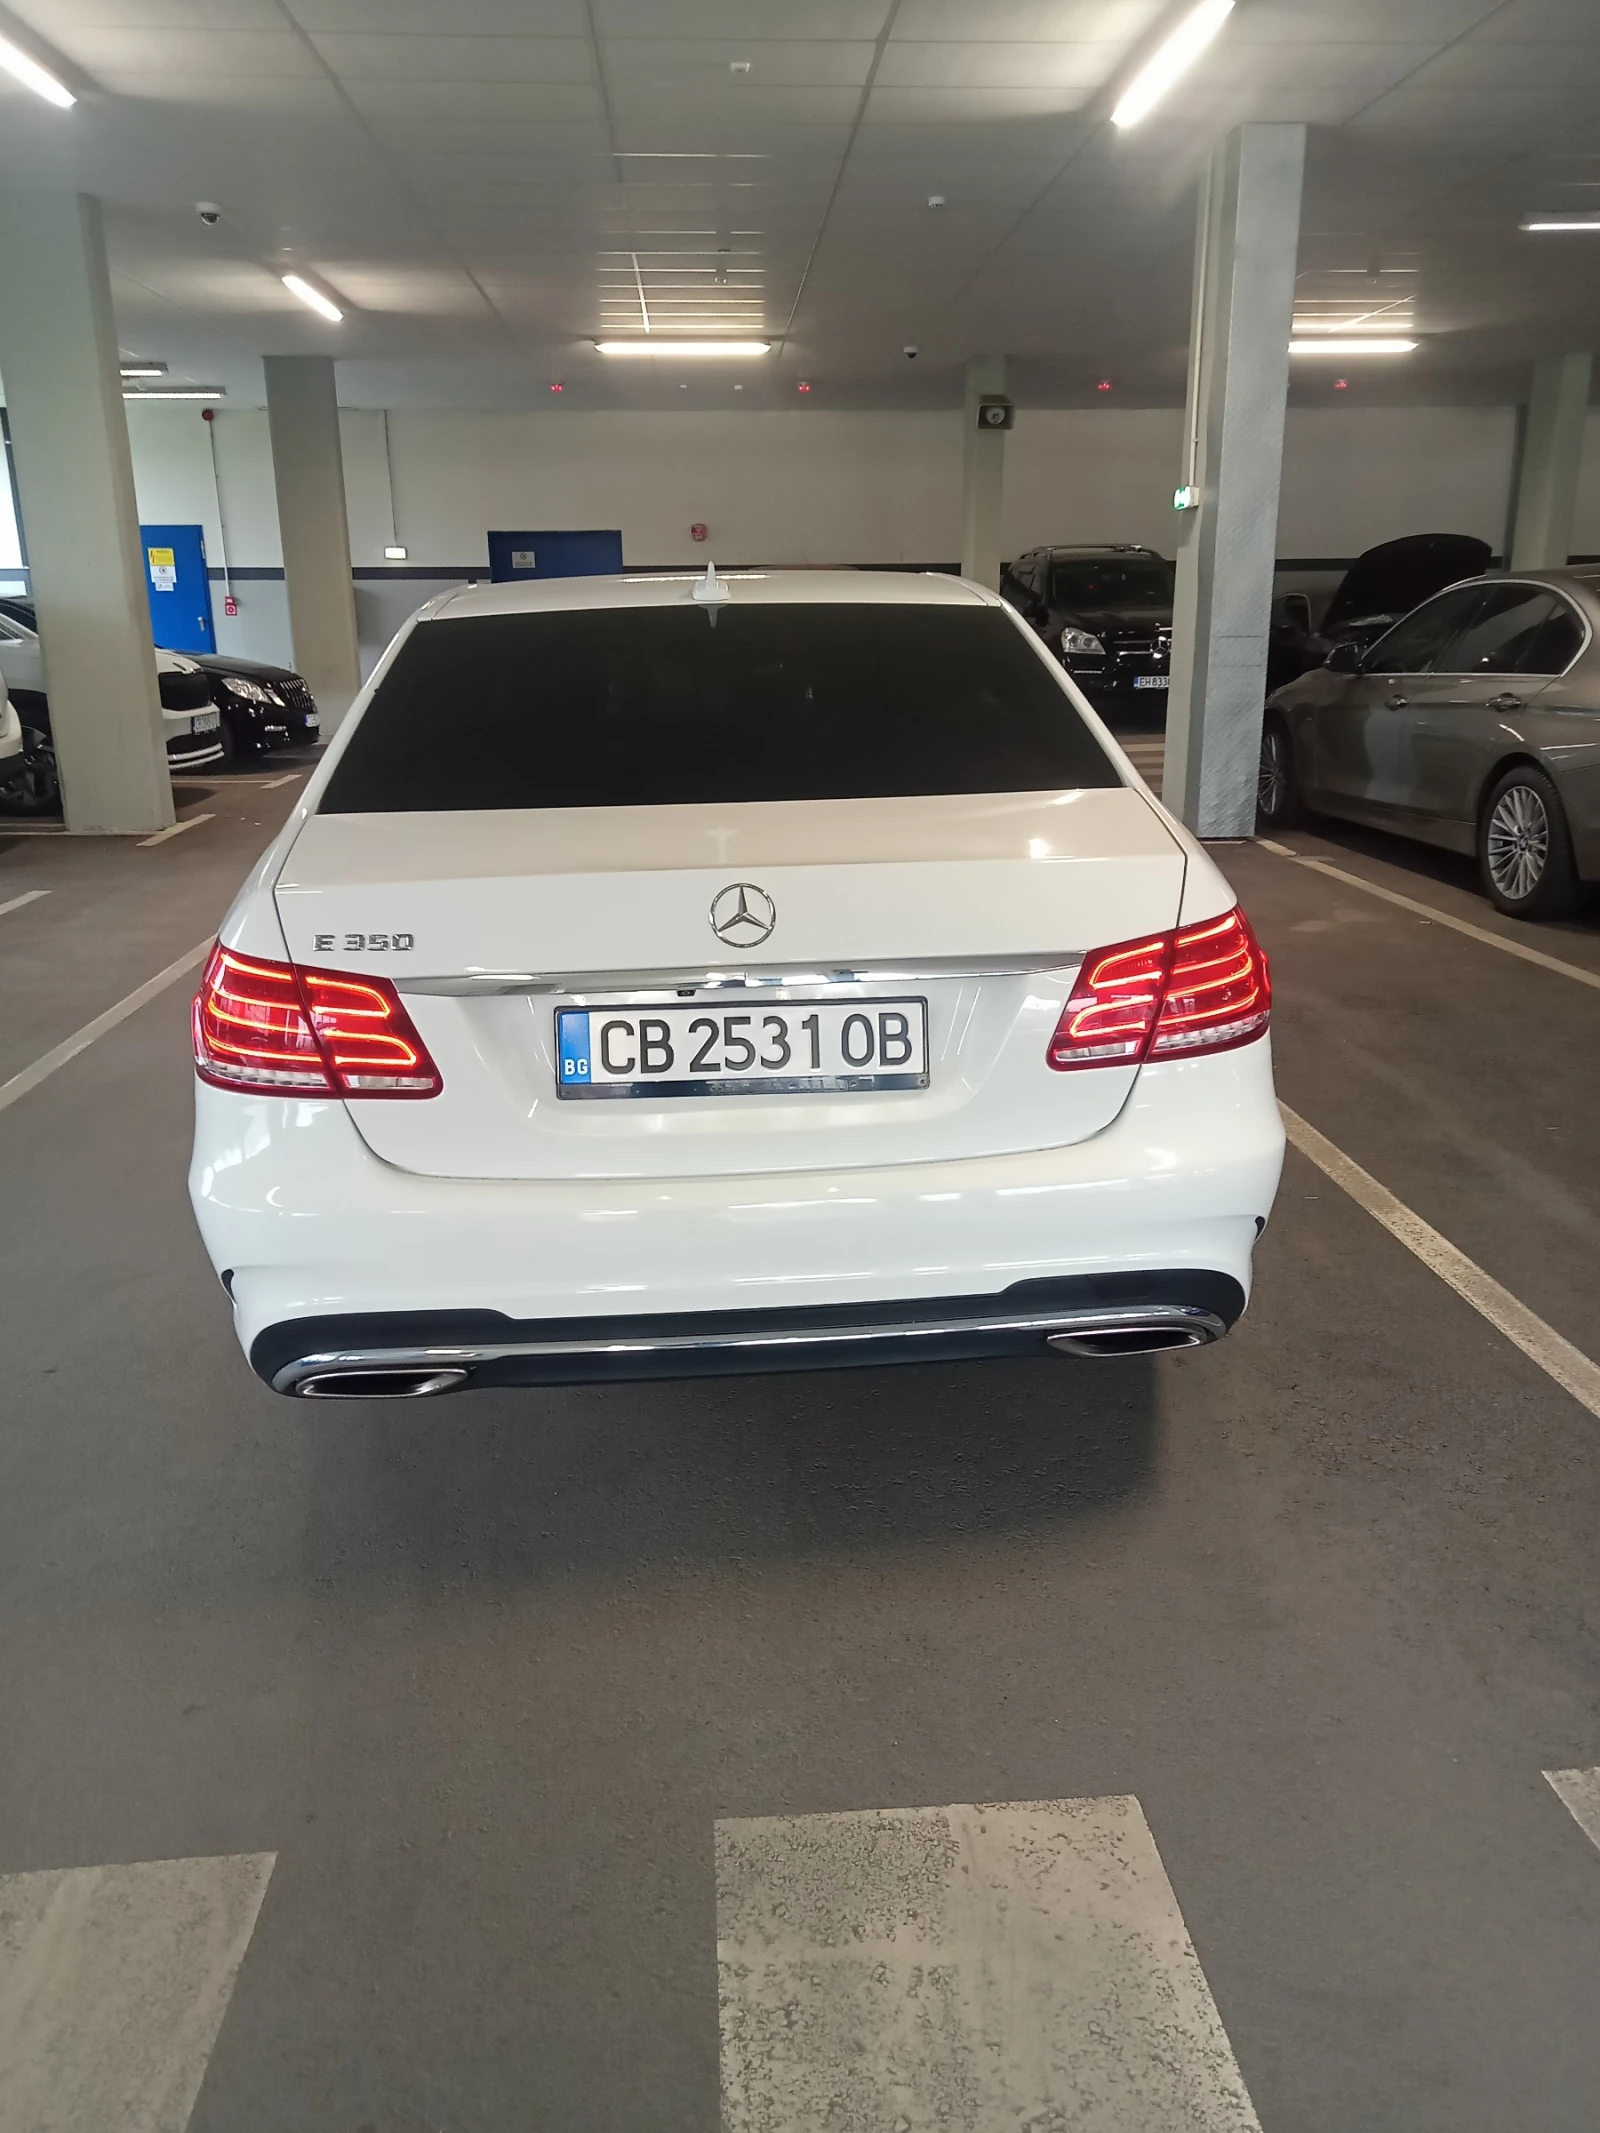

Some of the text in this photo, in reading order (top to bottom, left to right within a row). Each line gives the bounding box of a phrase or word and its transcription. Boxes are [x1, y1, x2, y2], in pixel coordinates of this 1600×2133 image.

[1139, 677, 1170, 687] EH 833
[313, 933, 414, 952] E 350
[600, 1012, 913, 1075] CB 2531 OB
[564, 1058, 589, 1076] BG
